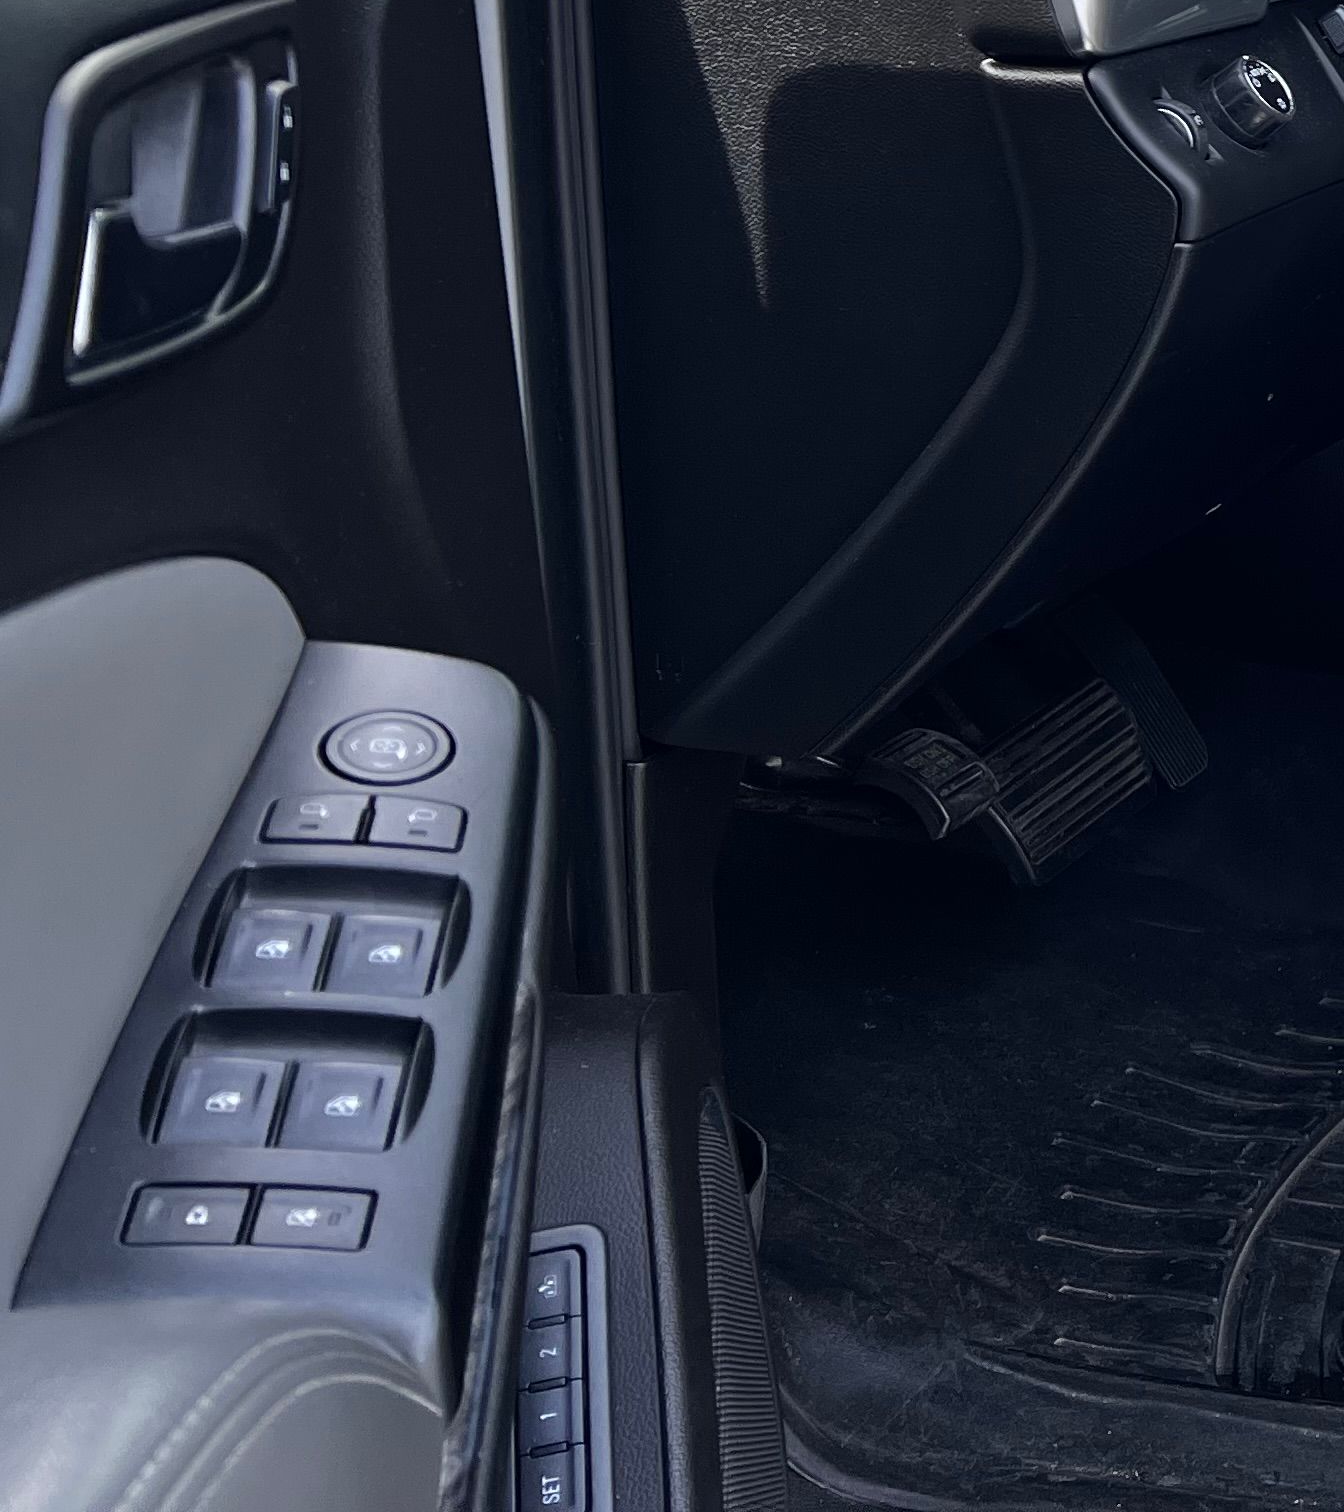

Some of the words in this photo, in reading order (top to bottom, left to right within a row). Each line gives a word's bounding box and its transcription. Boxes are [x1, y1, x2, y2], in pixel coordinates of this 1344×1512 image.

[539, 1346, 557, 1359] 2
[539, 1410, 558, 1421] 1
[541, 1474, 561, 1507] SET
